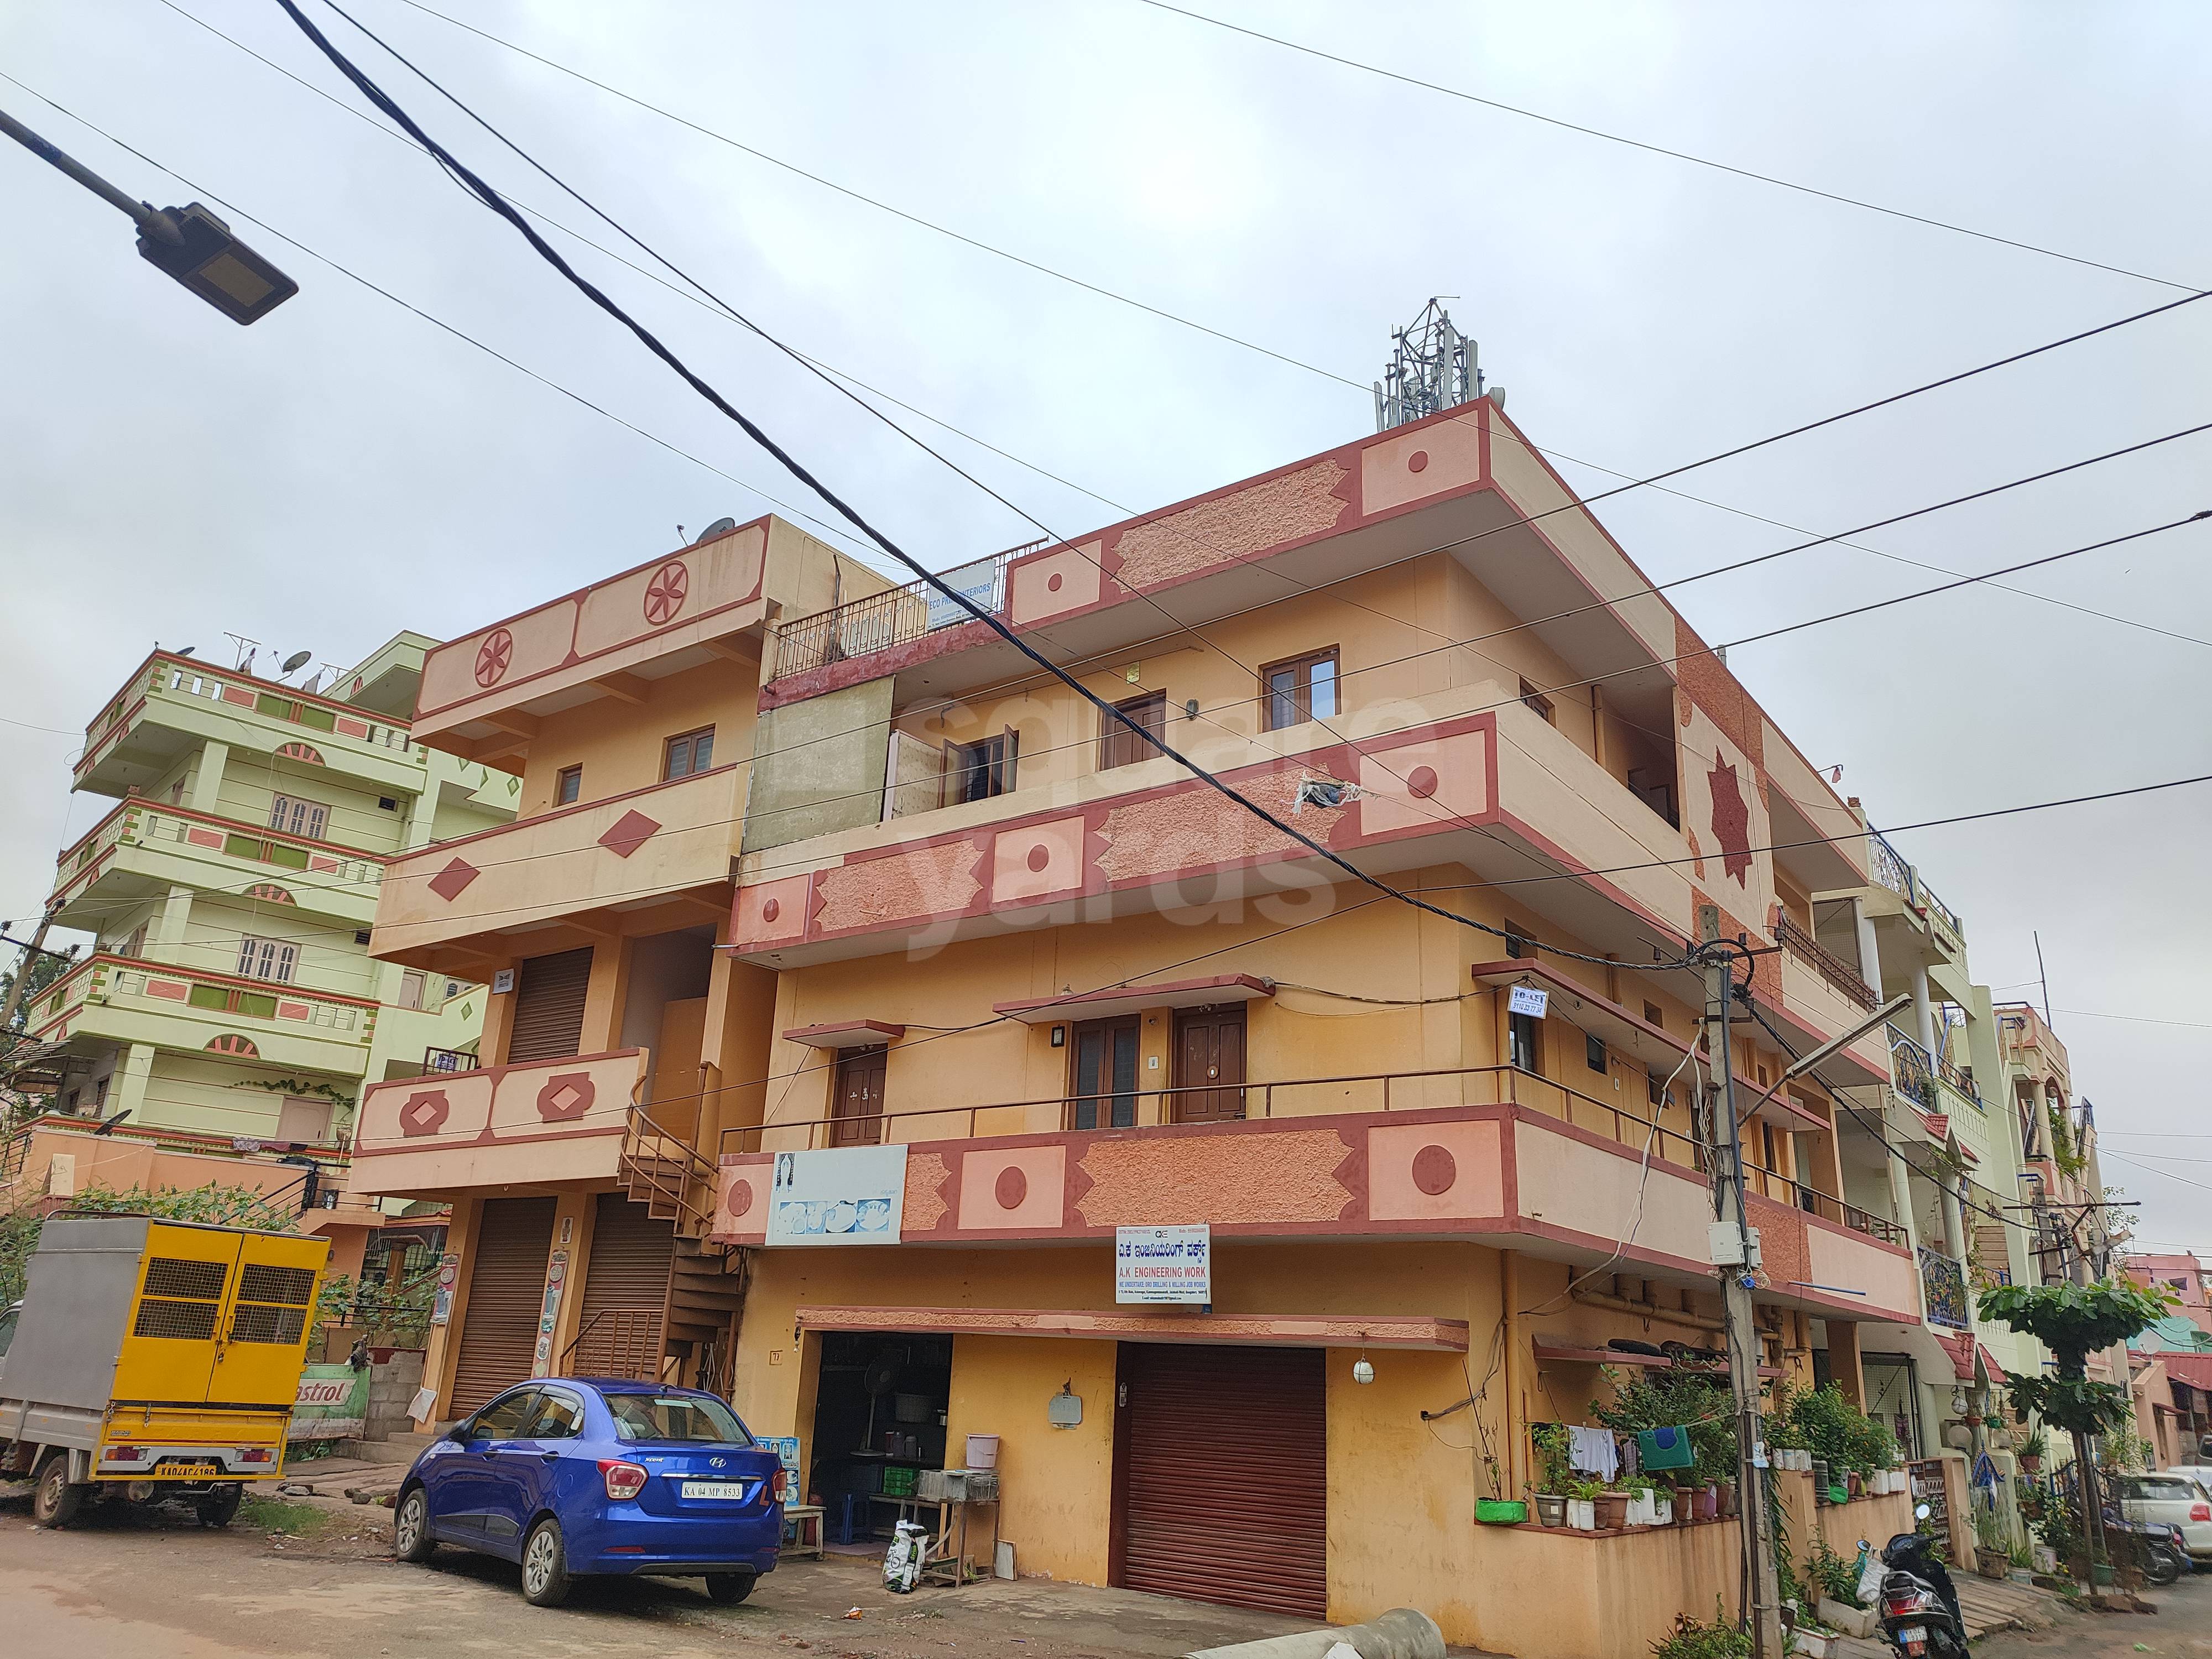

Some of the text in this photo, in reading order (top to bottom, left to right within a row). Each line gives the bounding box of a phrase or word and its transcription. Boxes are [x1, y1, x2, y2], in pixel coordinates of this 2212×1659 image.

[929, 598, 940, 610] ECO
[1119, 1266, 1206, 1278] A.K ENGINEERING WORK
[295, 1383, 345, 1401] astrol
[685, 1486, 695, 1496] KA
[698, 1487, 706, 1496] 04
[708, 1488, 720, 1496] MP
